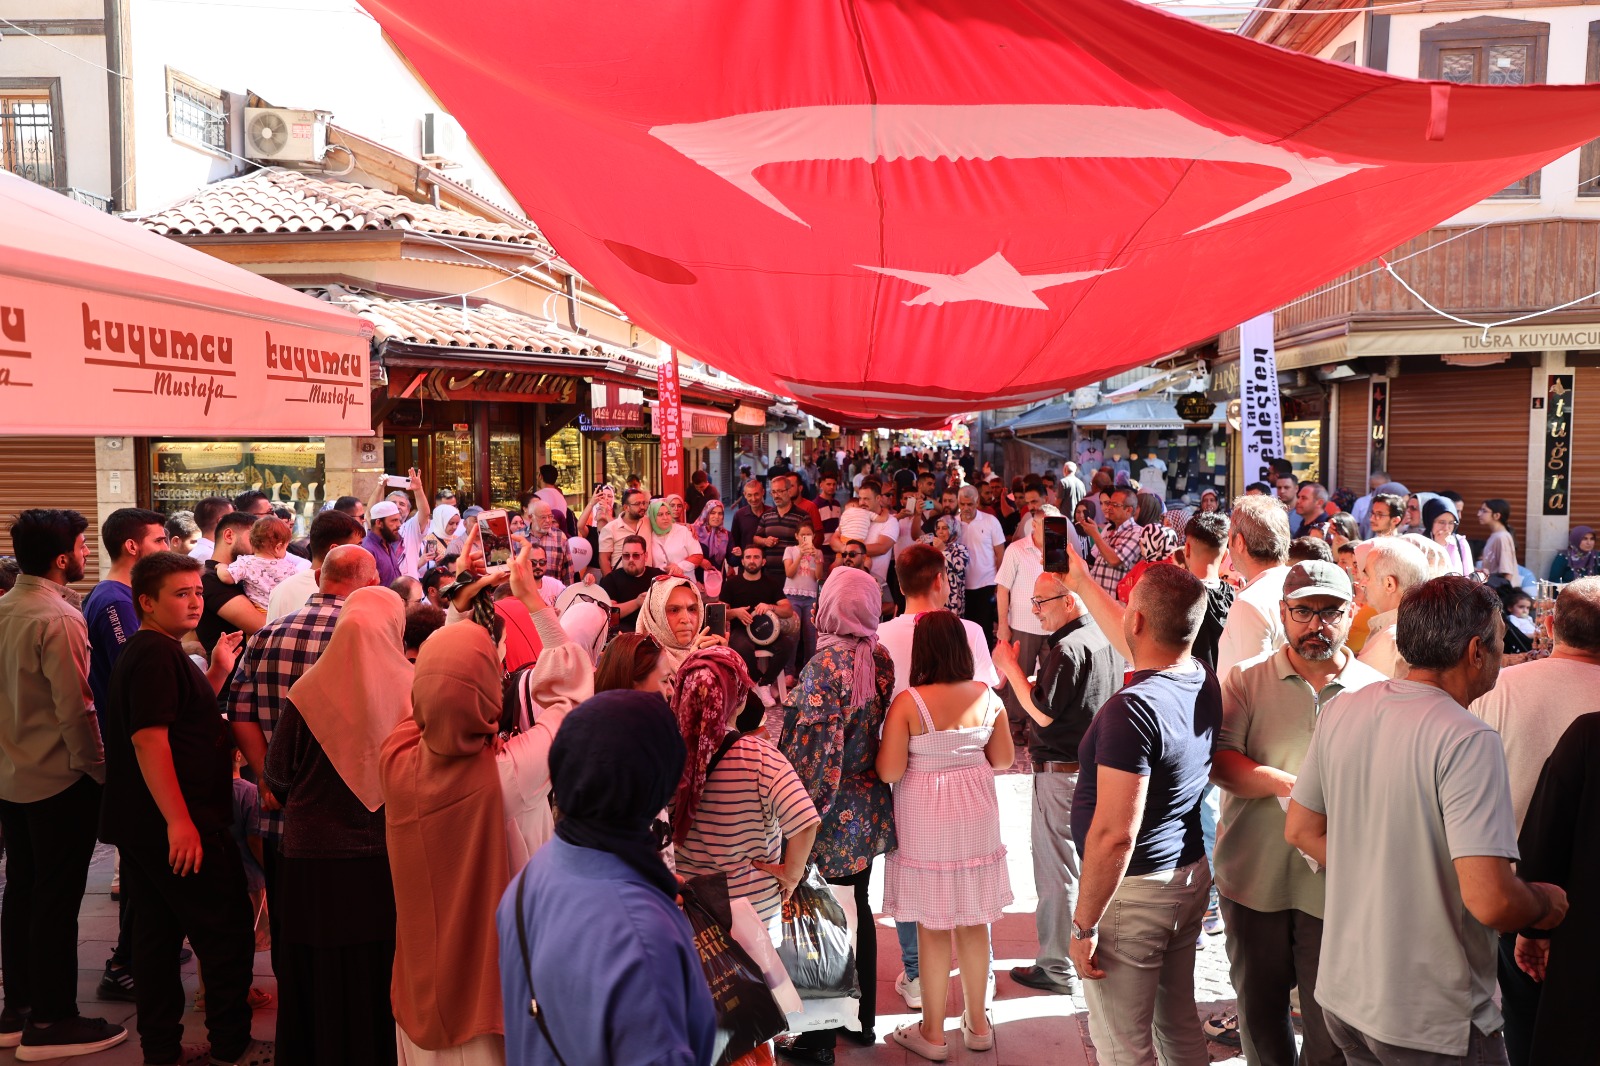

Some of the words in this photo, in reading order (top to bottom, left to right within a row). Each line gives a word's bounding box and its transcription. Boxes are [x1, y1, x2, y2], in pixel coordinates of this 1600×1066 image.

[82, 302, 233, 365] kuyumcu
[265, 331, 361, 380] kuyumcu
[1462, 334, 1514, 349] TUĞRA
[154, 371, 224, 416] Mustafa
[309, 384, 355, 420] Mustafa
[1548, 398, 1567, 510] tuğra
